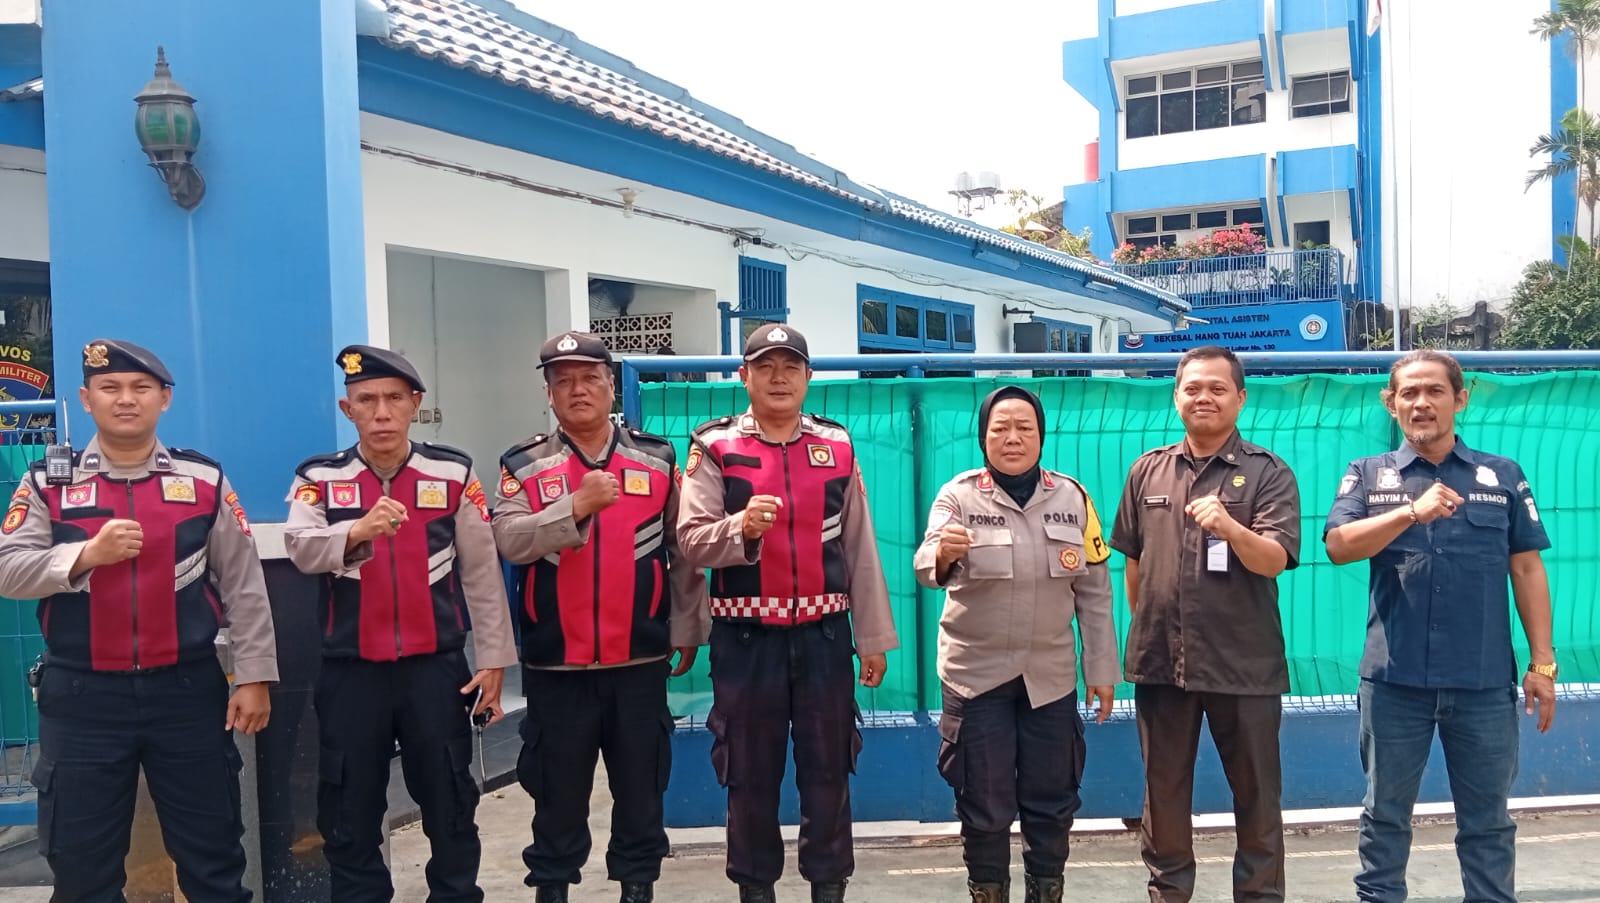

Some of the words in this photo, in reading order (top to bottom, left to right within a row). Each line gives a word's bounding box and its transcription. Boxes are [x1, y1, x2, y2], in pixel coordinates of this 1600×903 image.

[1231, 314, 1270, 323] ASISTEN
[1195, 332, 1220, 341] HANG
[1222, 331, 1247, 339] TUAH
[1249, 329, 1291, 338] JAKARTA
[1368, 494, 1401, 503] HASYIM
[968, 514, 1006, 526] PONCO
[1043, 512, 1080, 525] POLRI
